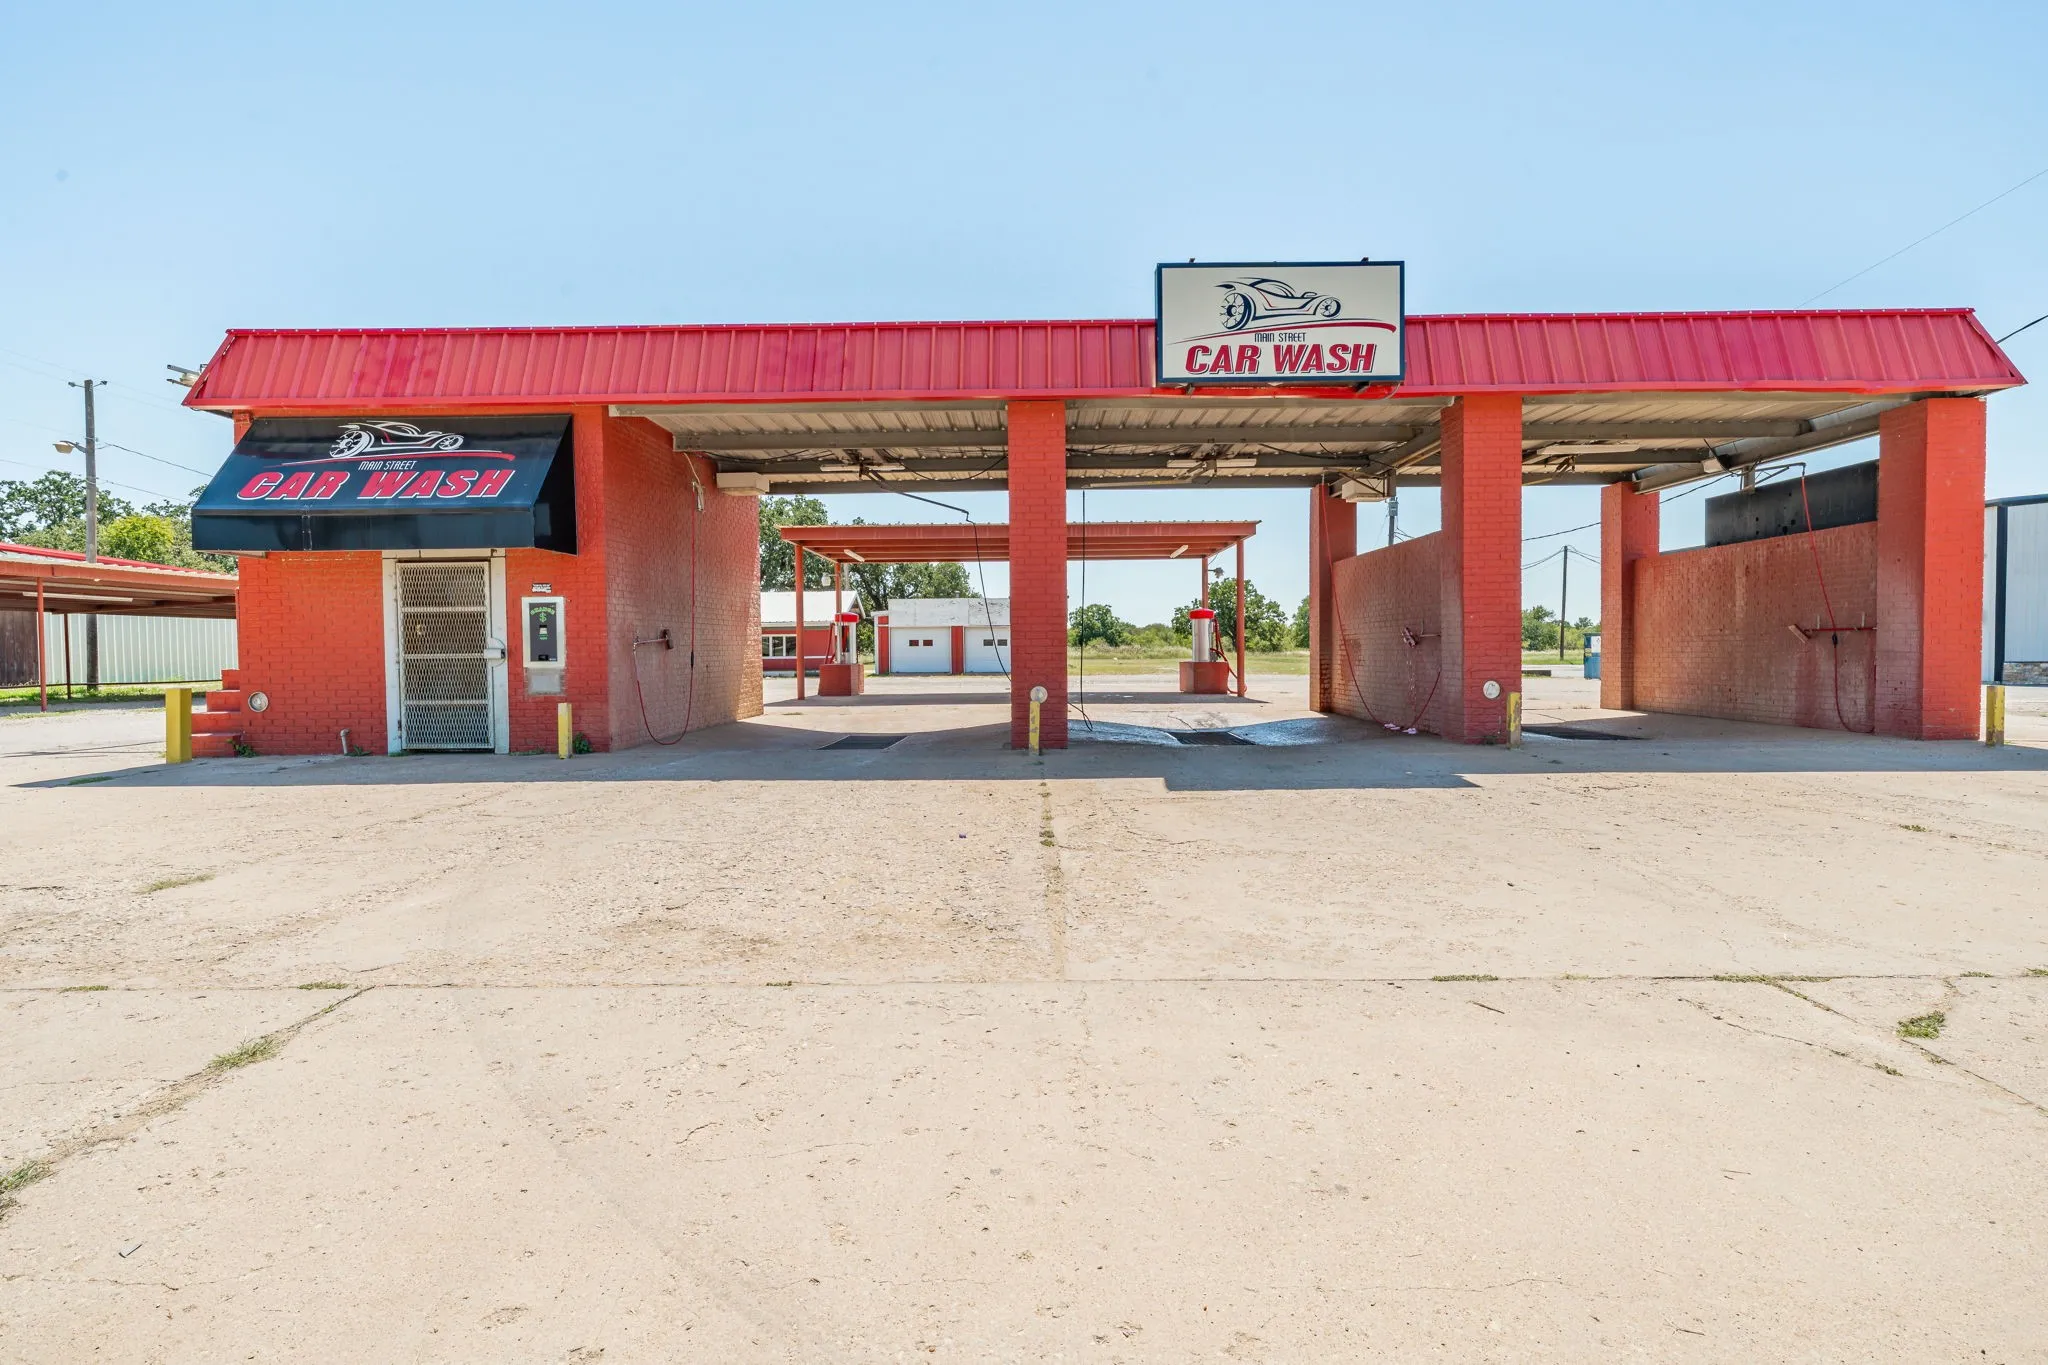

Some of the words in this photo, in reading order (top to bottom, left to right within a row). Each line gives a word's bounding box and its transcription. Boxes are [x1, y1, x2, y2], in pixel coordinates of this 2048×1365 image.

[1255, 332, 1275, 343] MAIN
[1278, 332, 1306, 343] STREET
[1185, 344, 1261, 374] CAR
[1273, 343, 1378, 374] WASH
[358, 460, 383, 471] MAIN
[383, 460, 417, 471] STREET
[236, 471, 350, 500] CAR
[357, 469, 516, 499] WASH
